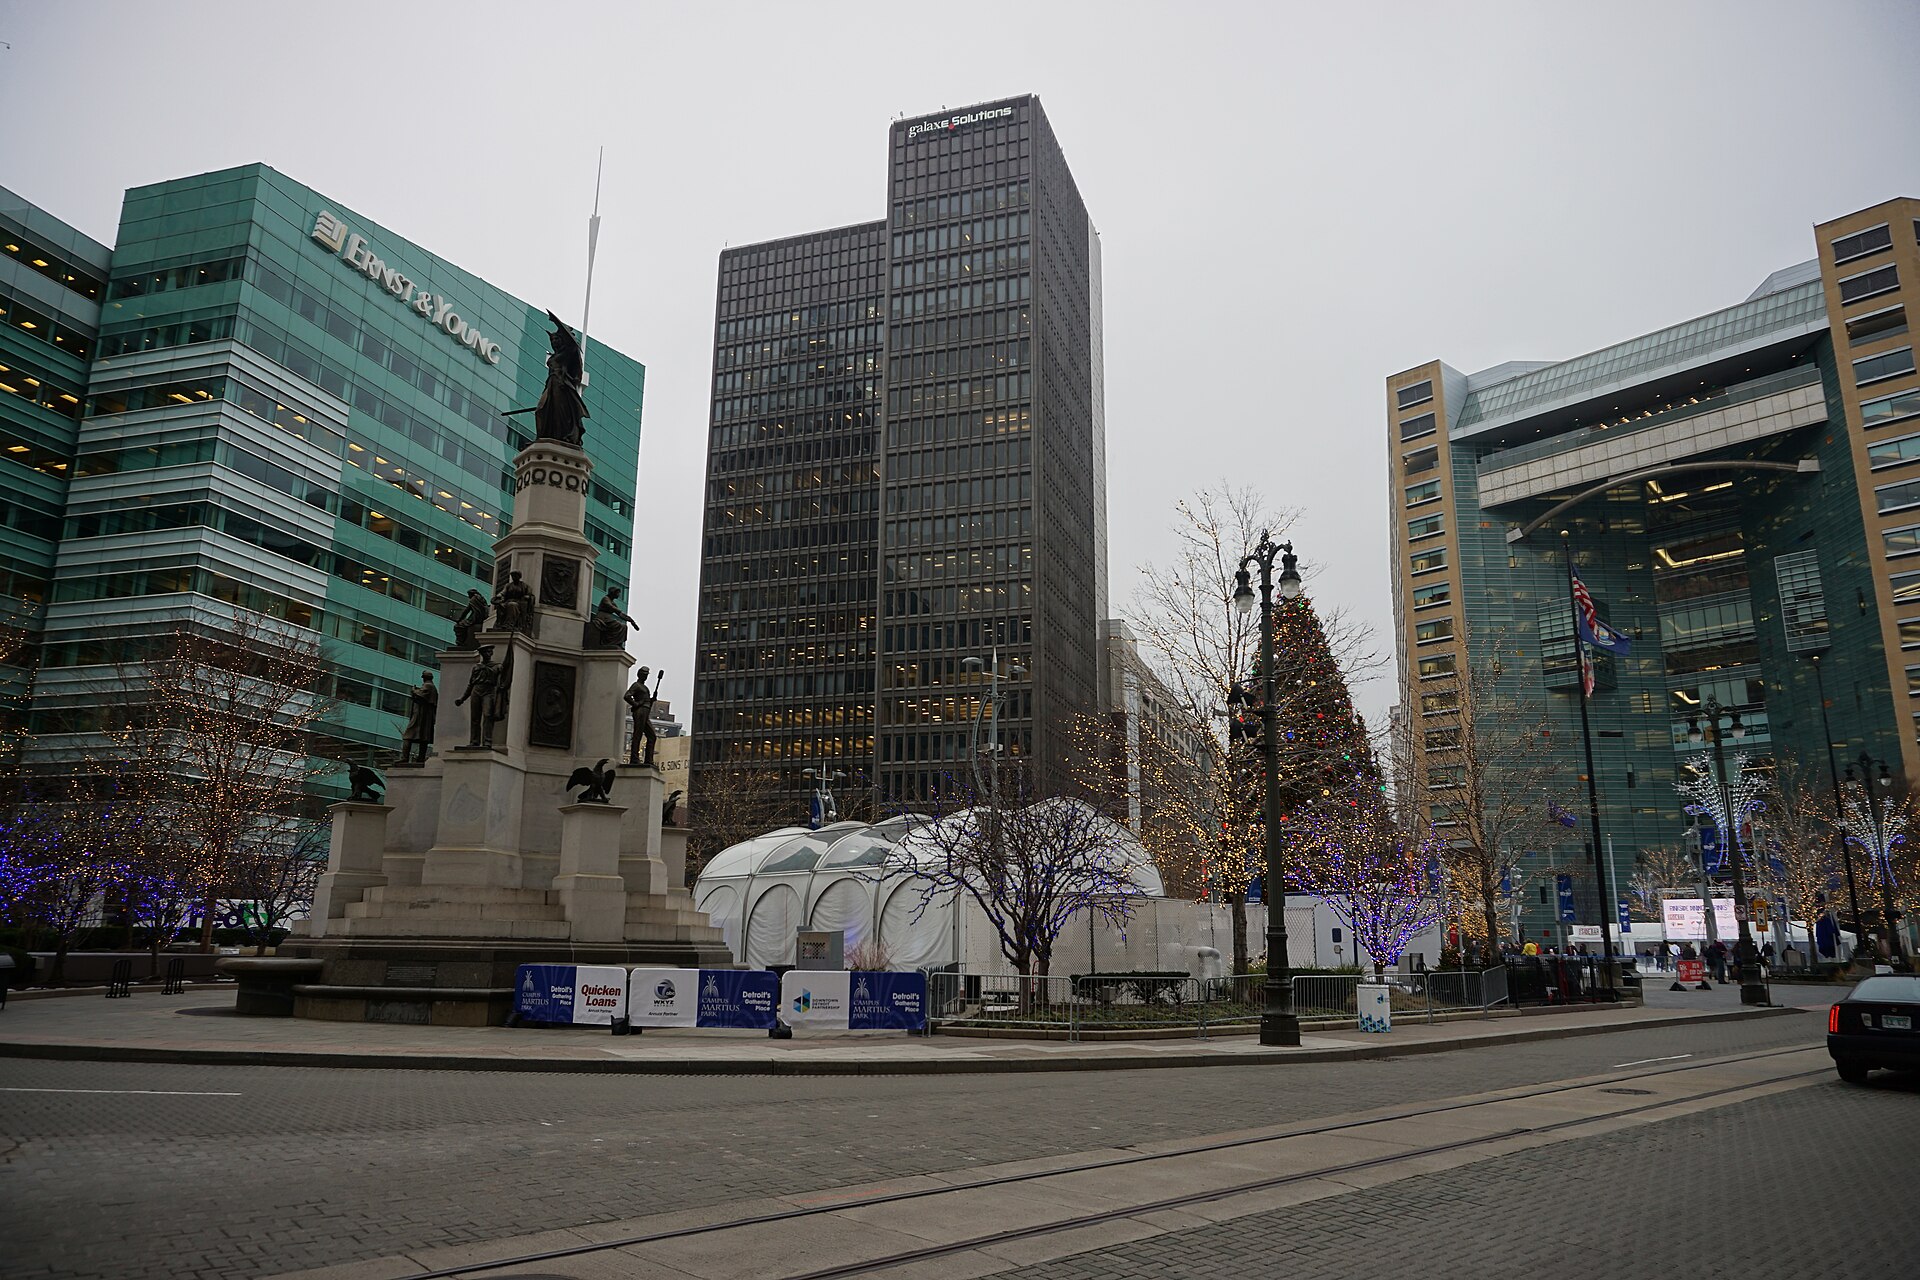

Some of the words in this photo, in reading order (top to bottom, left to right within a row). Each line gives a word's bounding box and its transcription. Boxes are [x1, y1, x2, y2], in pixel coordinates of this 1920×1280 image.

[343, 233, 417, 301] ERNST
[412, 291, 432, 317] &
[432, 294, 500, 364] YOUNG
[581, 984, 621, 996] Quicken
[586, 996, 617, 1007] Loans
[701, 1004, 740, 1012] MARTIUS
